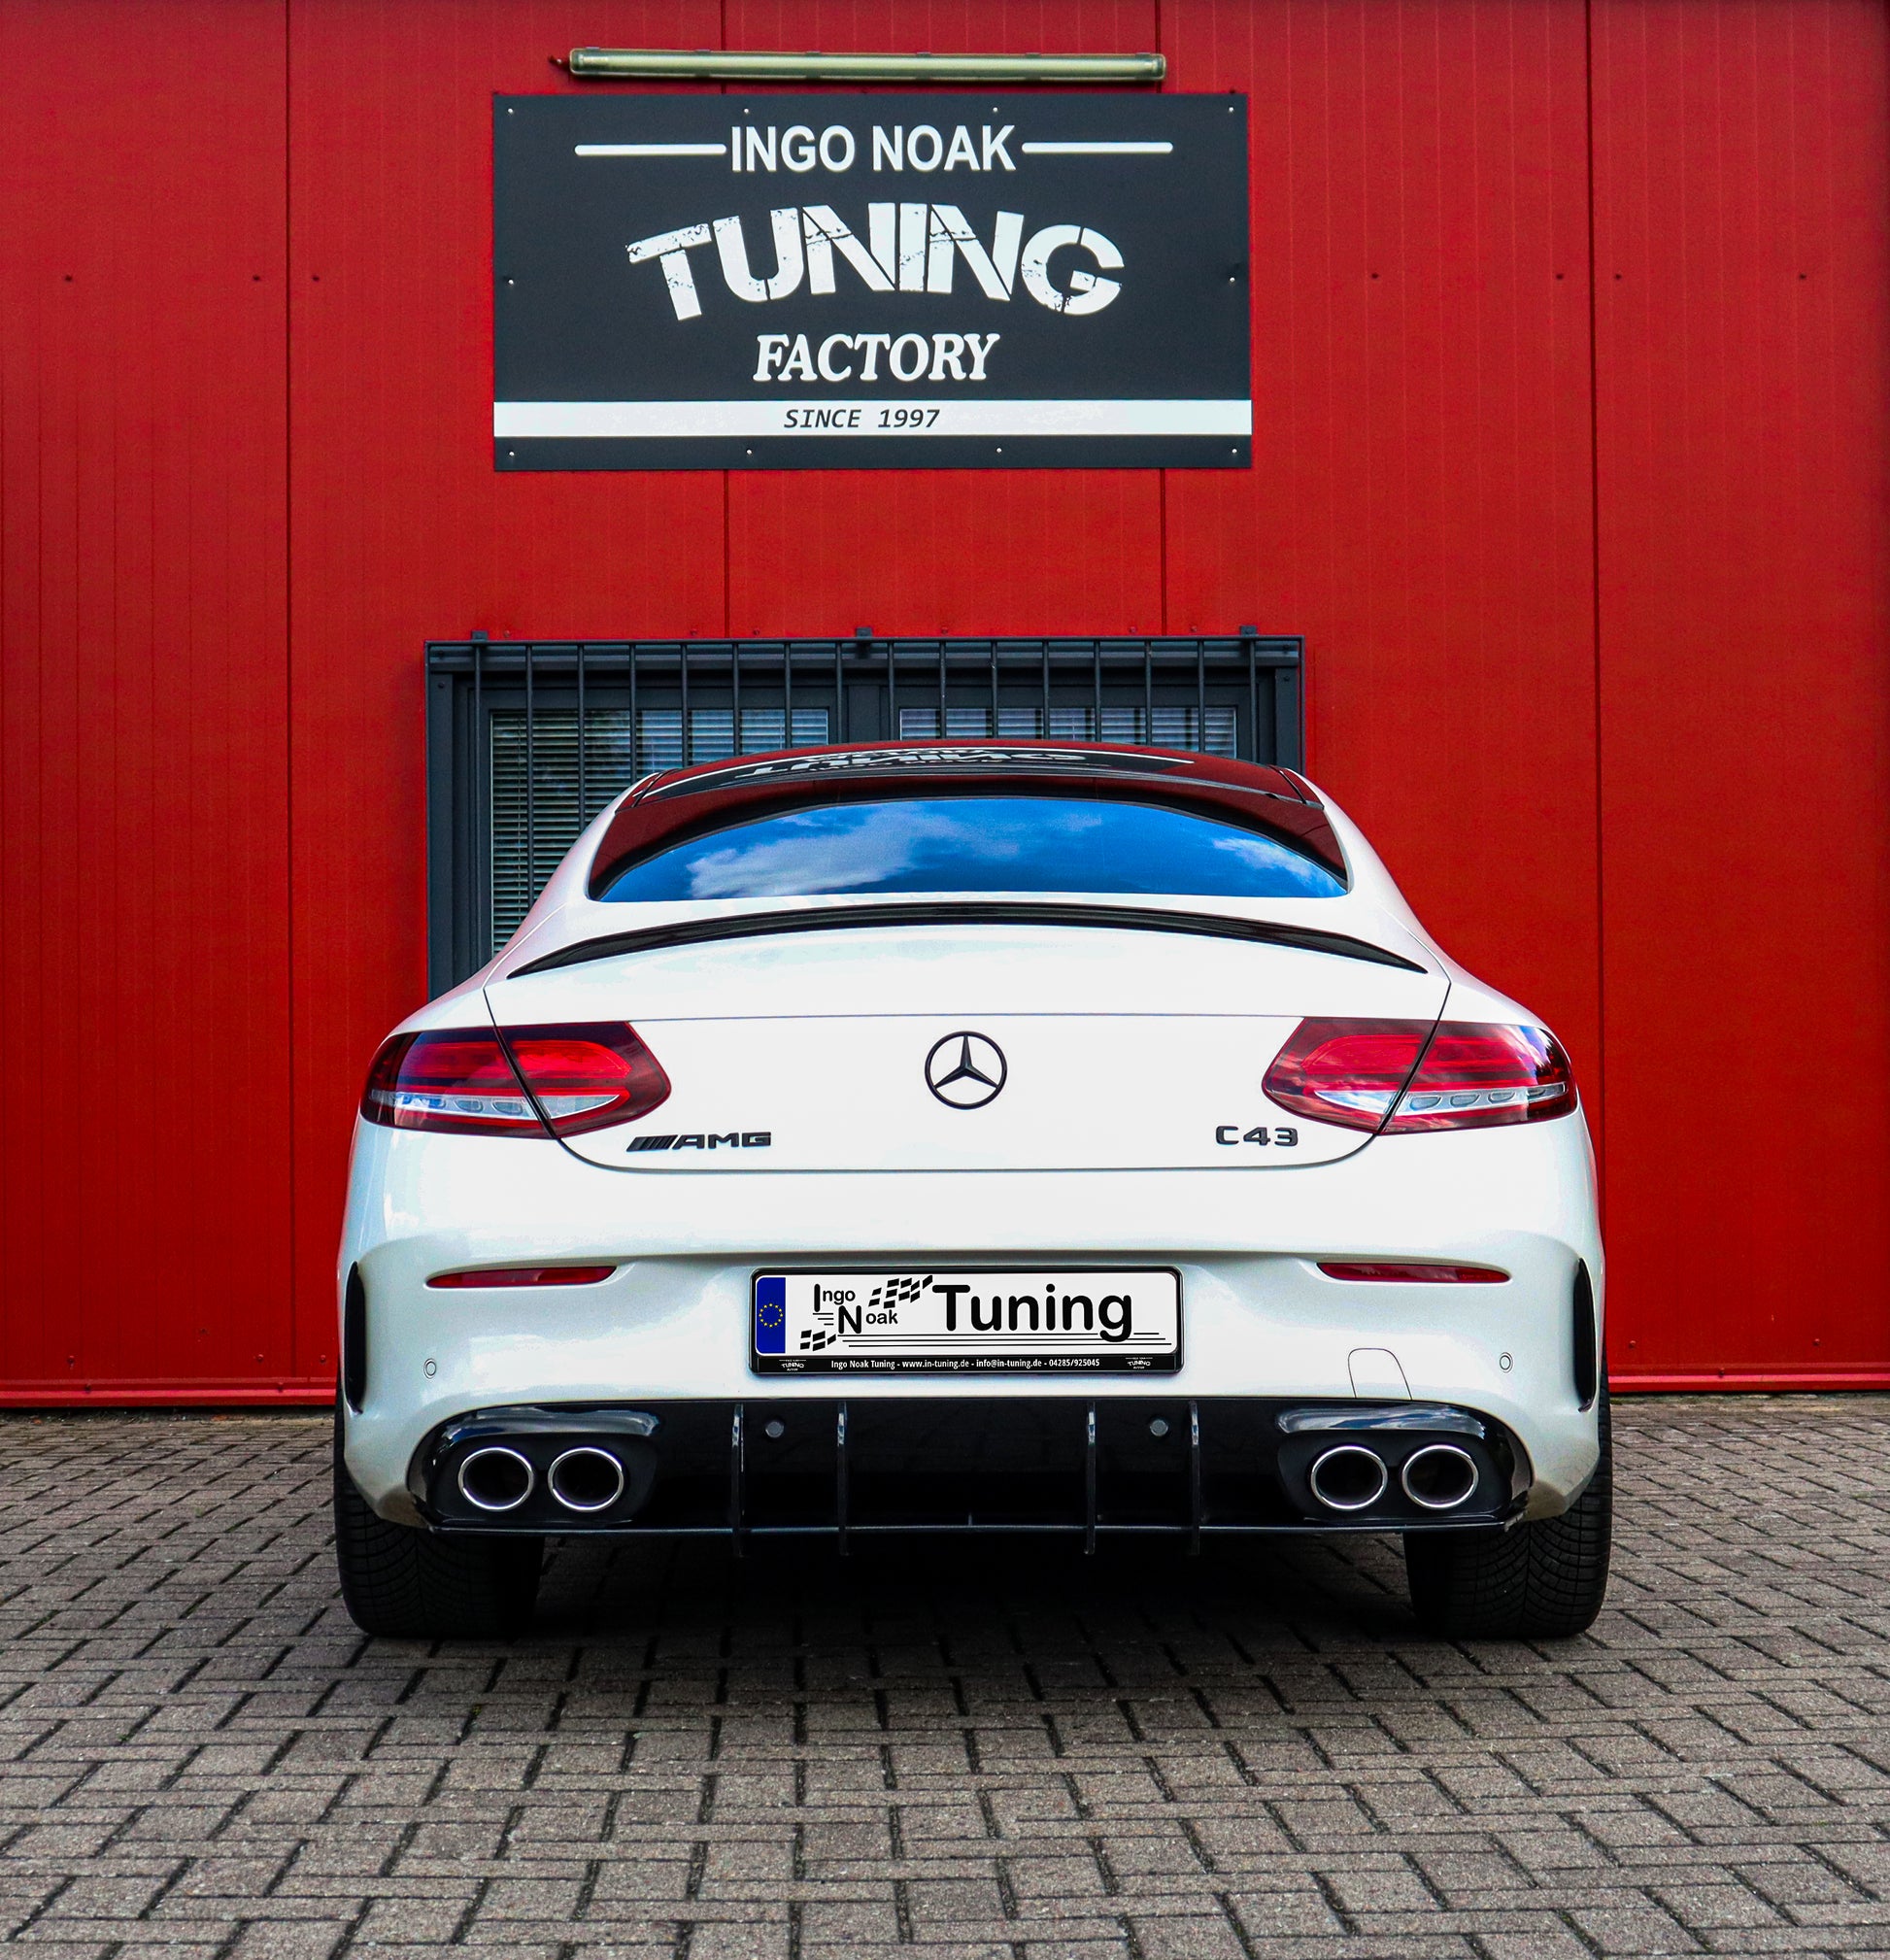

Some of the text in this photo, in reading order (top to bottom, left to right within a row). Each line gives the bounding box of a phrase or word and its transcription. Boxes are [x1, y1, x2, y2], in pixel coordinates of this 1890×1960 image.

[731, 124, 1017, 172] INGO NOAK
[625, 202, 1126, 321] TUNING
[752, 333, 1001, 382] FACTORY
[783, 408, 941, 429] SINCE 1997
[672, 1132, 772, 1150] AMG
[1215, 1126, 1299, 1146] C43
[814, 1283, 856, 1313] Ingo
[931, 1283, 1132, 1343] Tuning
[838, 1304, 898, 1335] Noak
[830, 1360, 848, 1370] Ingo
[849, 1360, 869, 1369] Noak
[870, 1360, 895, 1370] Tuning
[901, 1359, 969, 1369] www.in-tuning.de
[976, 1359, 1042, 1369] info@in-tuning.de
[1049, 1358, 1100, 1368] 04285/925045
